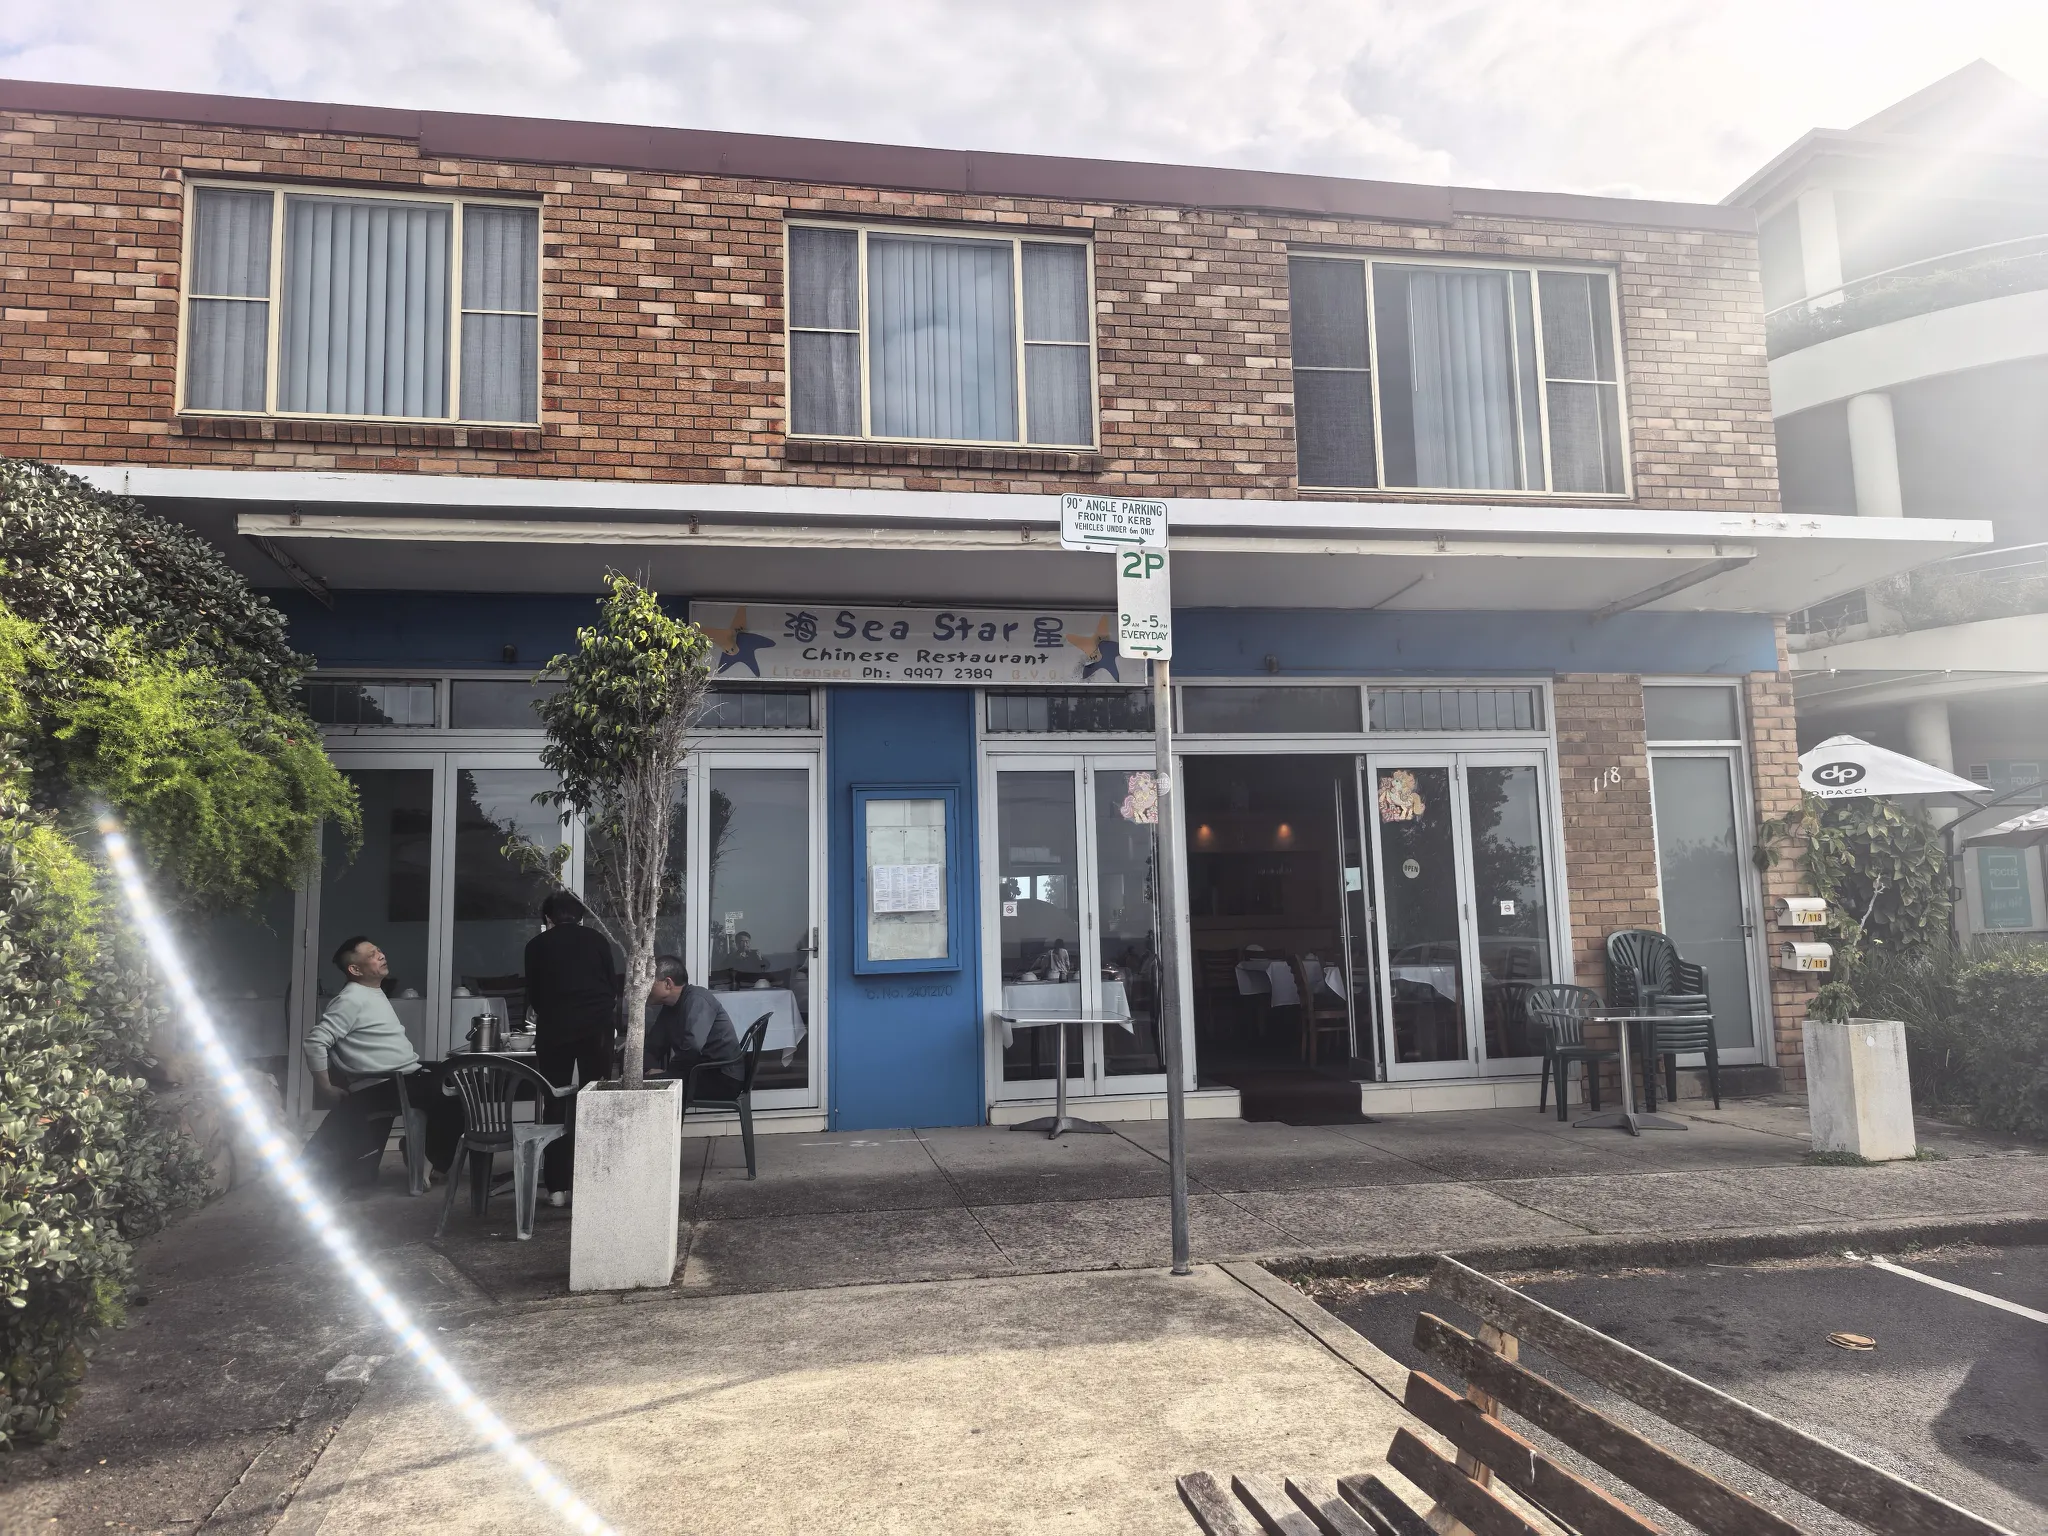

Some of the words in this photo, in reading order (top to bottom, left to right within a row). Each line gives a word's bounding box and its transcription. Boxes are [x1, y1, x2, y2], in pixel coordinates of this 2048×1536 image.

[1086, 500, 1117, 512] ANGLE
[1122, 503, 1163, 516] PARKING
[1078, 512, 1107, 522] FRONT
[1113, 514, 1123, 524] TO
[1128, 516, 1151, 526] KERB
[1075, 522, 1104, 532] VEHICLES
[1107, 525, 1127, 534] UNDER
[1141, 528, 1155, 536] ONLY
[1122, 552, 1164, 579] 2P
[833, 610, 909, 642] Sea
[933, 613, 1019, 642] Star
[1121, 630, 1168, 640] EVERYDAY
[802, 647, 899, 662] Chinese
[917, 649, 1049, 665] Restaurant
[772, 664, 852, 678] Licensed
[863, 667, 890, 678] Ph:
[904, 667, 943, 679] 9997
[954, 668, 993, 679] 2389
[1594, 766, 1621, 795] 118
[1990, 868, 2019, 877] FOCUS
[1796, 912, 1822, 924] 1/118
[1802, 957, 1827, 969] 2/118
